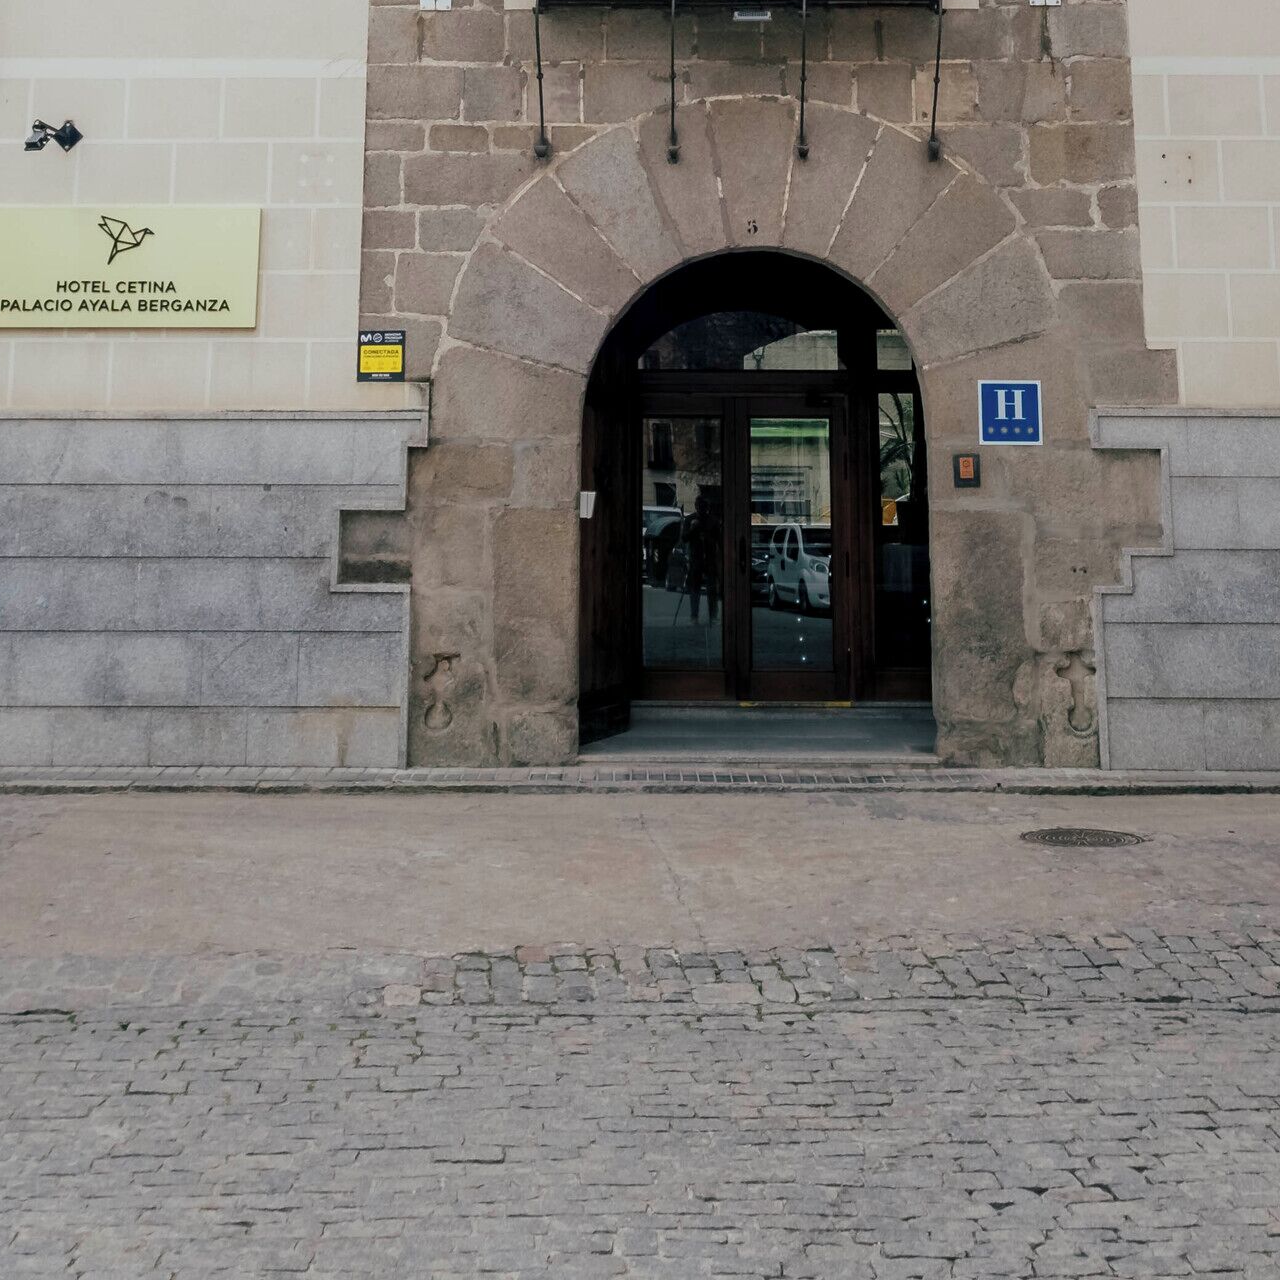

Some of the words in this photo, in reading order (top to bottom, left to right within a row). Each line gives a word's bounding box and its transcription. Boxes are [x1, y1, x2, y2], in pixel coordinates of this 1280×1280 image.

[56, 280, 110, 293] HOTEL
[115, 281, 177, 293] CETINA
[0, 299, 73, 312] PALACIO
[78, 299, 132, 312] AYALA
[137, 299, 231, 312] BERGANZA
[993, 389, 1027, 420] H
